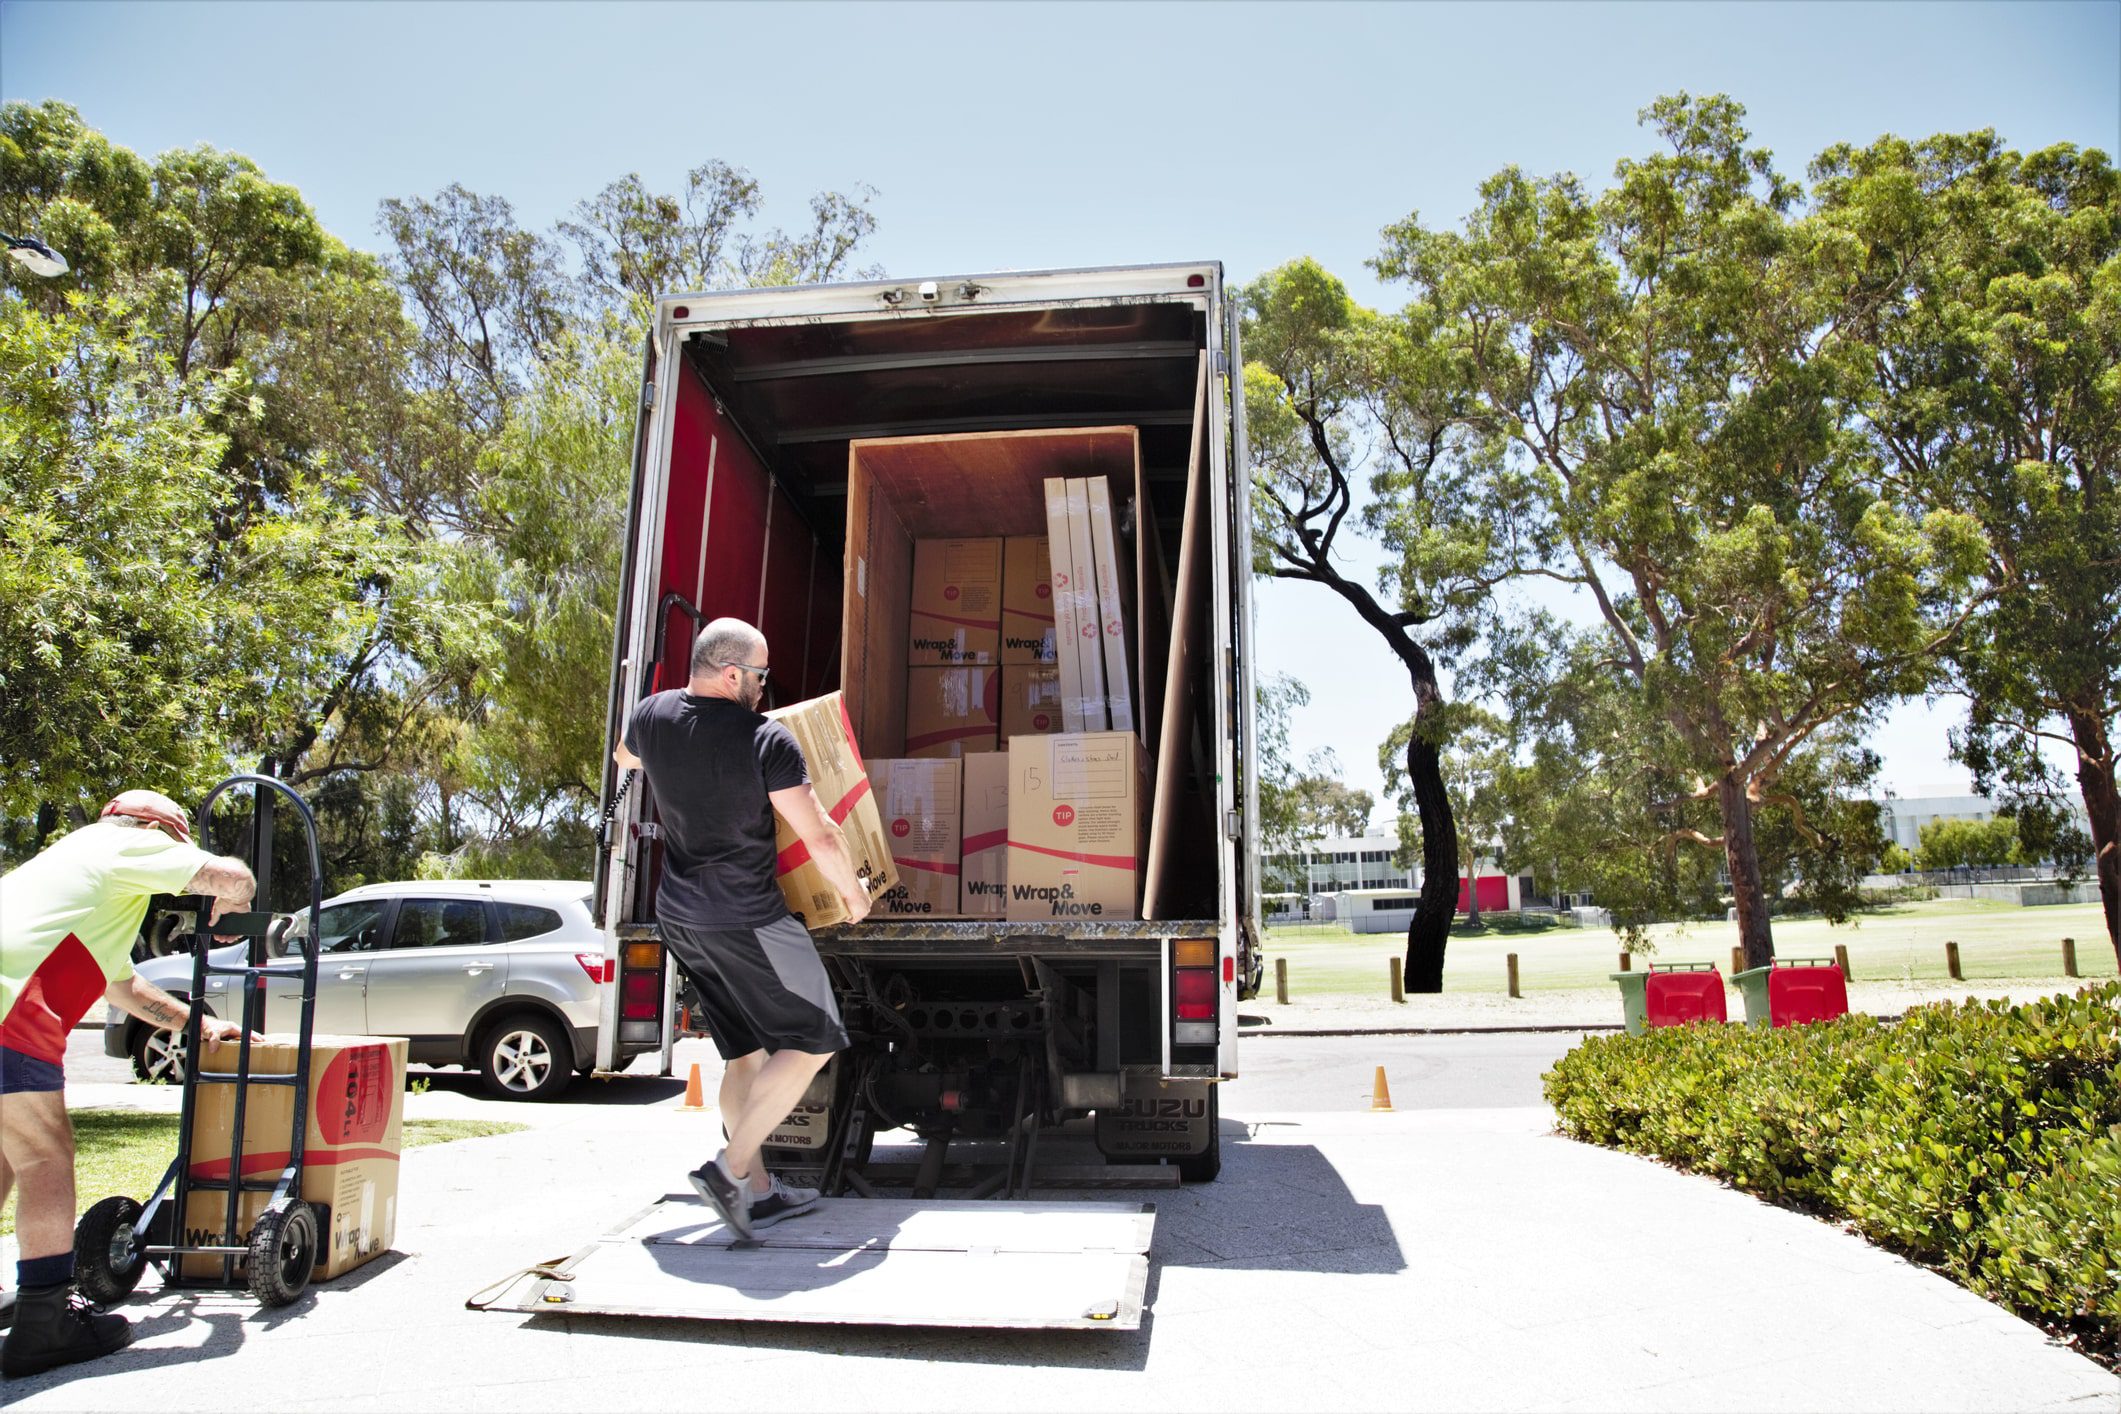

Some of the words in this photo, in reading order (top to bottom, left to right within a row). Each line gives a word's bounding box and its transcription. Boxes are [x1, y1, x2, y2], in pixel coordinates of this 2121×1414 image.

[913, 638, 958, 653] Wrap&
[940, 649, 976, 660] Move
[1023, 767, 1042, 794] 15
[1055, 811, 1072, 820] TIP
[894, 823, 909, 833] TIP
[1012, 883, 1075, 906] Wrap&
[889, 900, 932, 913] Move
[1052, 900, 1102, 916] Move
[142, 1000, 179, 1022] Lloyd
[1108, 1098, 1205, 1119] SUZU
[1119, 1120, 1188, 1133] TRUCKS
[775, 1135, 812, 1145] MOTORS
[1116, 1141, 1150, 1151] MAJOR
[1151, 1141, 1192, 1152] MOTORS
